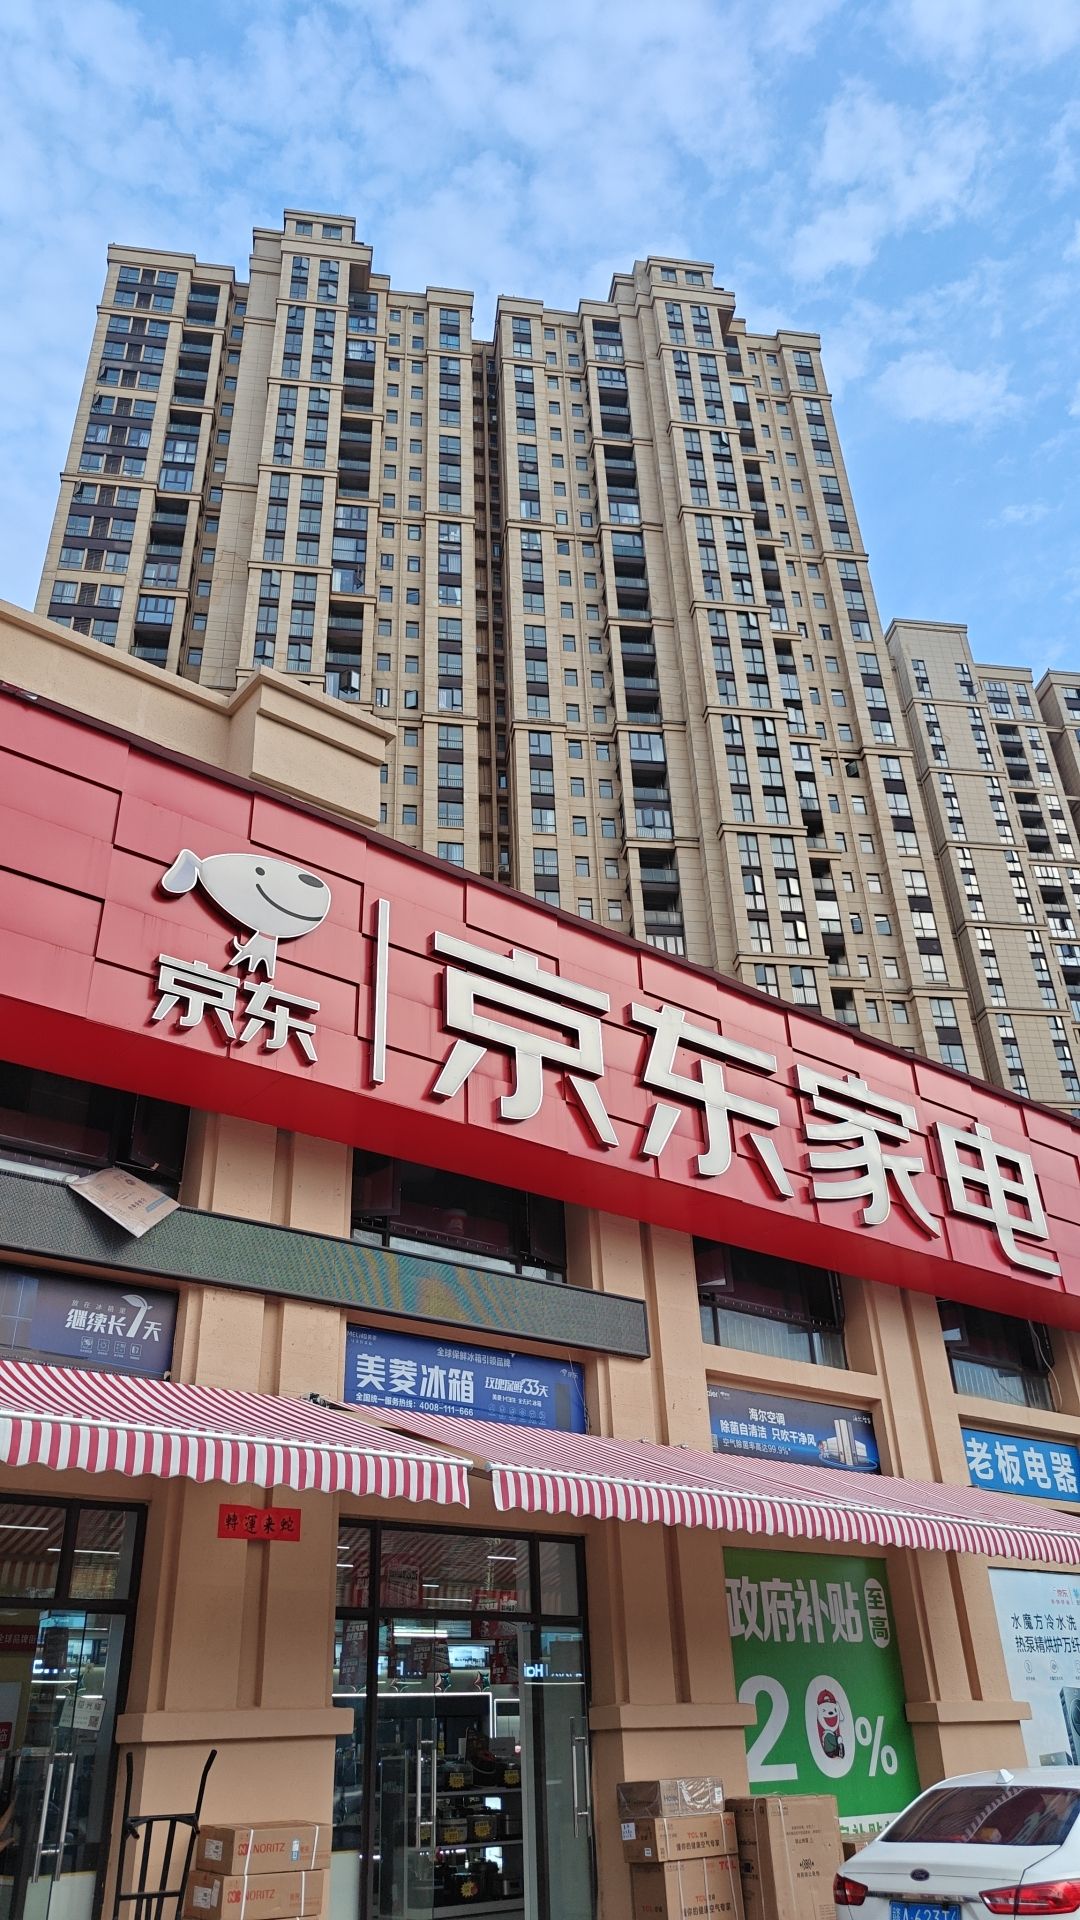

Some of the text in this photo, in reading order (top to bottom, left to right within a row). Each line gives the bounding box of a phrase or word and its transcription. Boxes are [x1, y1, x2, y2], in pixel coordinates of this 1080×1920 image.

[152, 953, 320, 1061] 京东
[432, 931, 1061, 1277] 京东家电
[356, 1353, 474, 1404] 美菱冰箱
[437, 1346, 513, 1368] 全球保鲜冰箱引领品牌
[719, 1419, 817, 1447] 除菌自清洁 只吹干净风
[748, 1407, 787, 1426] 海尔空调
[966, 1437, 1078, 1493] 老板电器
[725, 1576, 864, 1643] 政府补贴
[866, 1587, 888, 1641] 至高
[1011, 1612, 1077, 1630] 水魔方冷水洗
[738, 1675, 898, 1782] 20%
[254, 1843, 285, 1854] NORITZ
